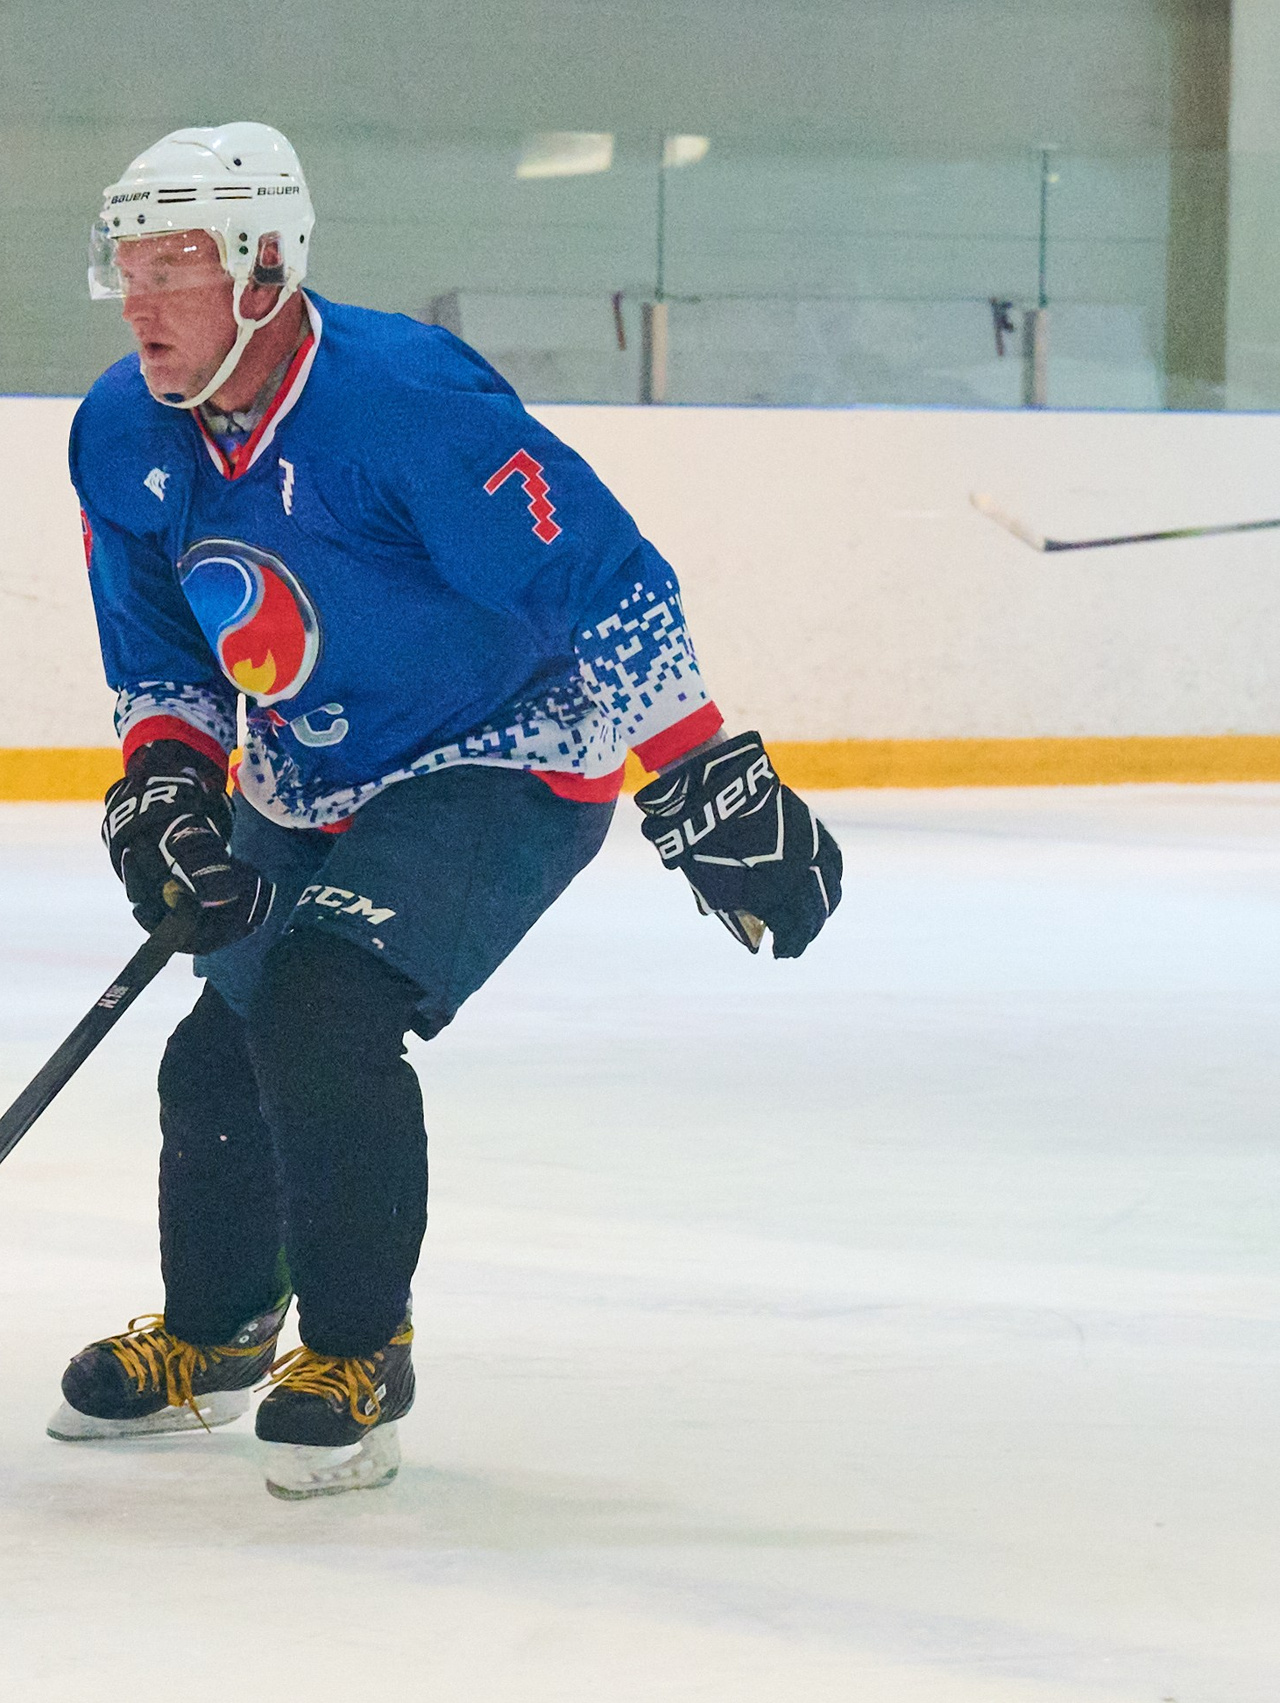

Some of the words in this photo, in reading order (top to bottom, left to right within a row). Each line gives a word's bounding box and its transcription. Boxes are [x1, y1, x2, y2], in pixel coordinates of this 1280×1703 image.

[111, 191, 151, 204] BAUER
[257, 186, 300, 196] BAUER
[483, 448, 562, 545] 7
